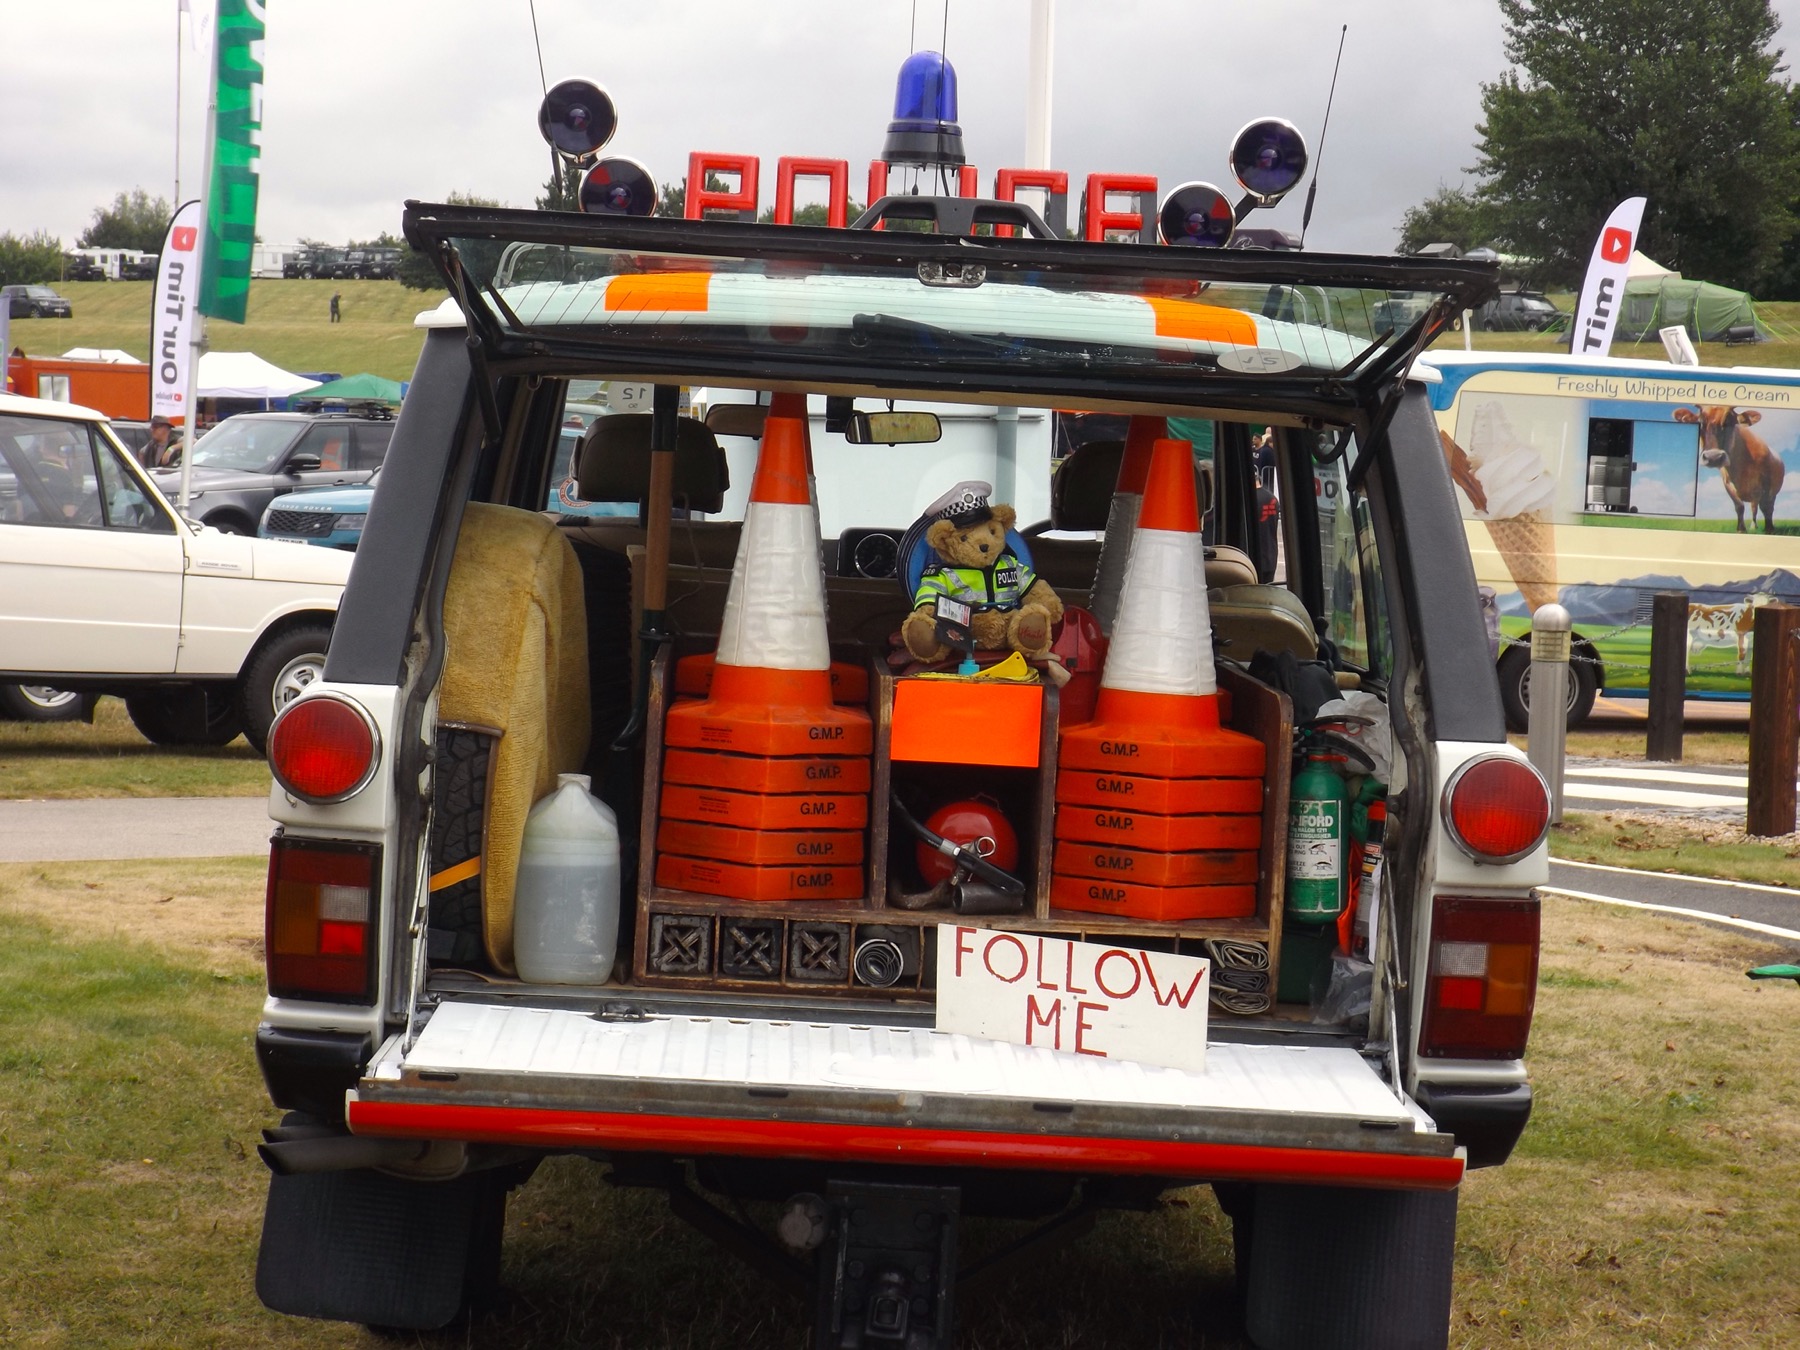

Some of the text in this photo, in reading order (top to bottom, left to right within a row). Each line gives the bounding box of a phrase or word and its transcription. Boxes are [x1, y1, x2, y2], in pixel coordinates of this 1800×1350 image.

[1583, 277, 1615, 352] Tim
[1557, 376, 1790, 402] Freshly Whipped Ice Cream
[997, 571, 1018, 585] POLIC
[809, 727, 845, 740] G.M.P.
[1100, 741, 1140, 757] G.M.P.
[806, 766, 843, 780] G.M.P.
[1096, 778, 1135, 795] G.M.P.
[800, 802, 837, 815] G.M.P.
[1095, 814, 1134, 830] G.M.P.
[796, 843, 835, 855] G.M.P.
[1094, 854, 1134, 871] G.M.P.
[797, 873, 834, 887] G.M.P.
[1088, 886, 1127, 902] G.M.P.
[955, 926, 1206, 1009] FOLLOW
[1025, 994, 1109, 1058] ME
